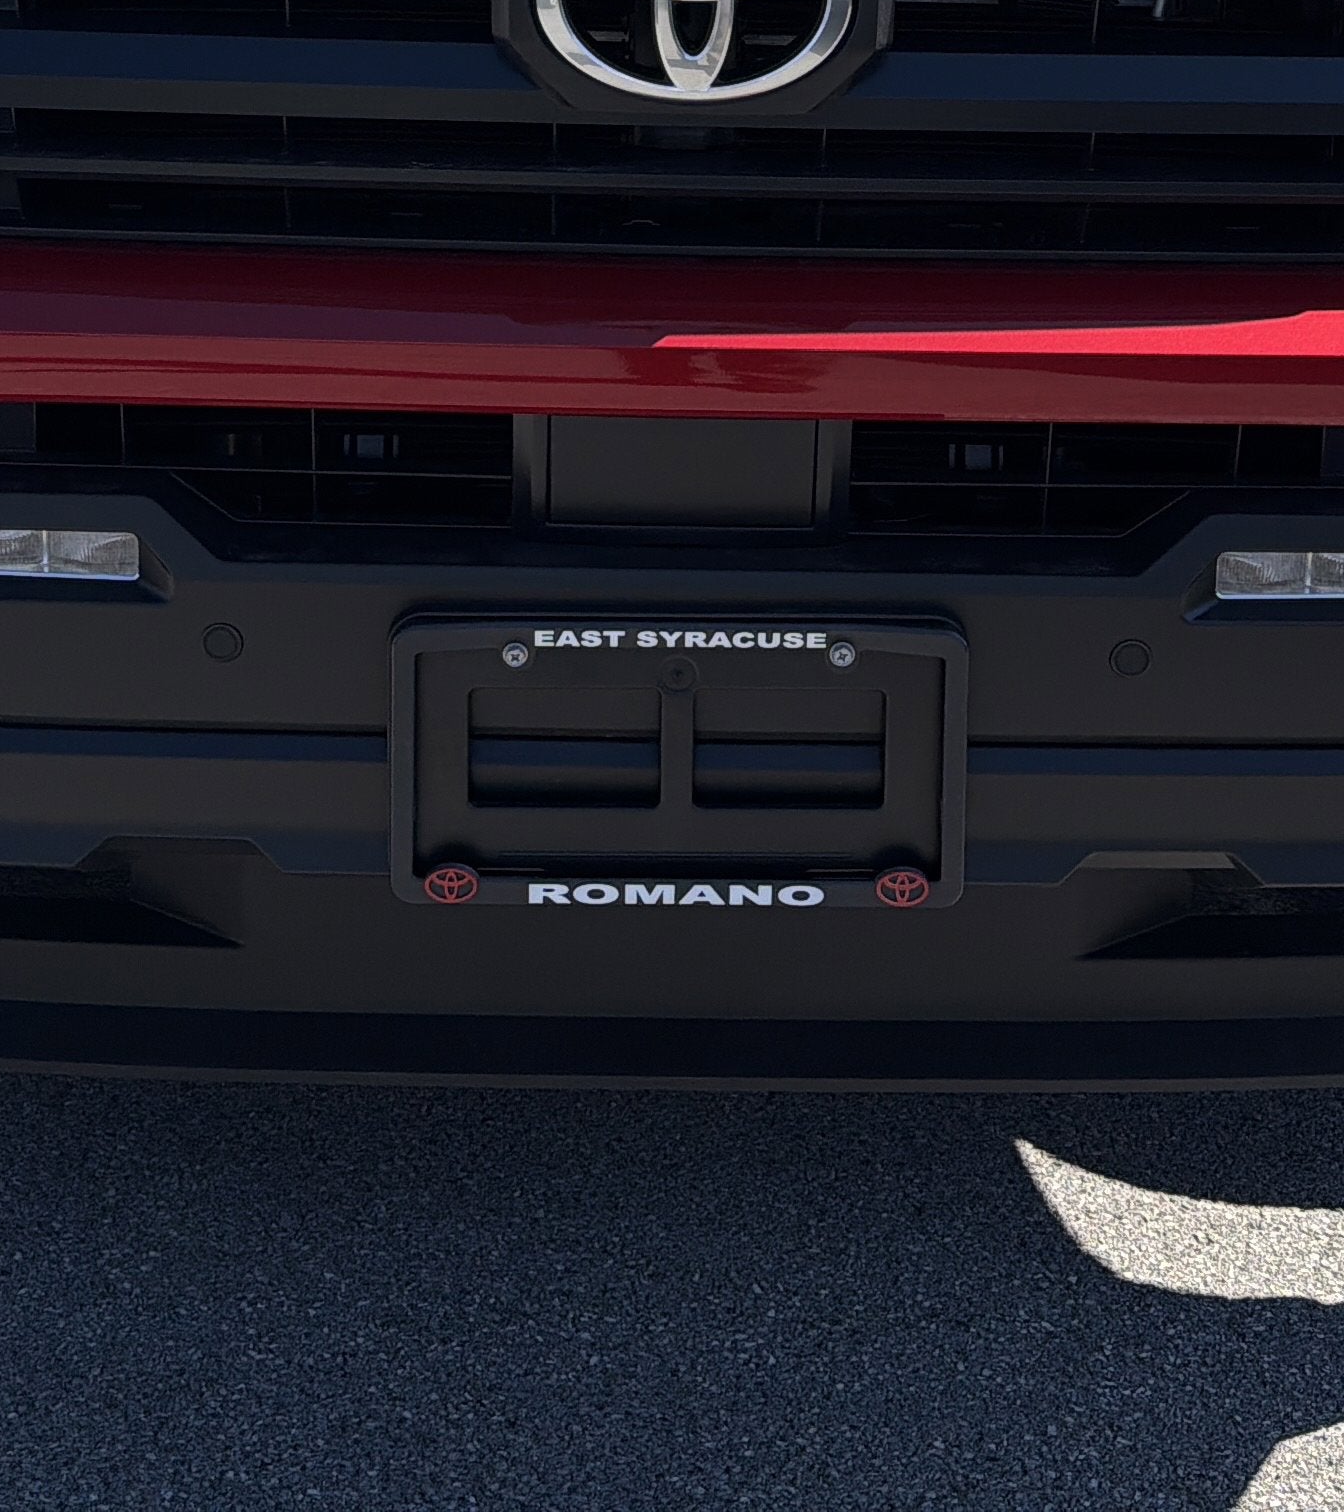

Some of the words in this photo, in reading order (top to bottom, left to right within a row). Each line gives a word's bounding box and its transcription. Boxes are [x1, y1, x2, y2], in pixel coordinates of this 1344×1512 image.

[535, 630, 626, 648] EAST
[636, 630, 827, 649] SYRACUSE
[528, 883, 825, 907] ROMANO
